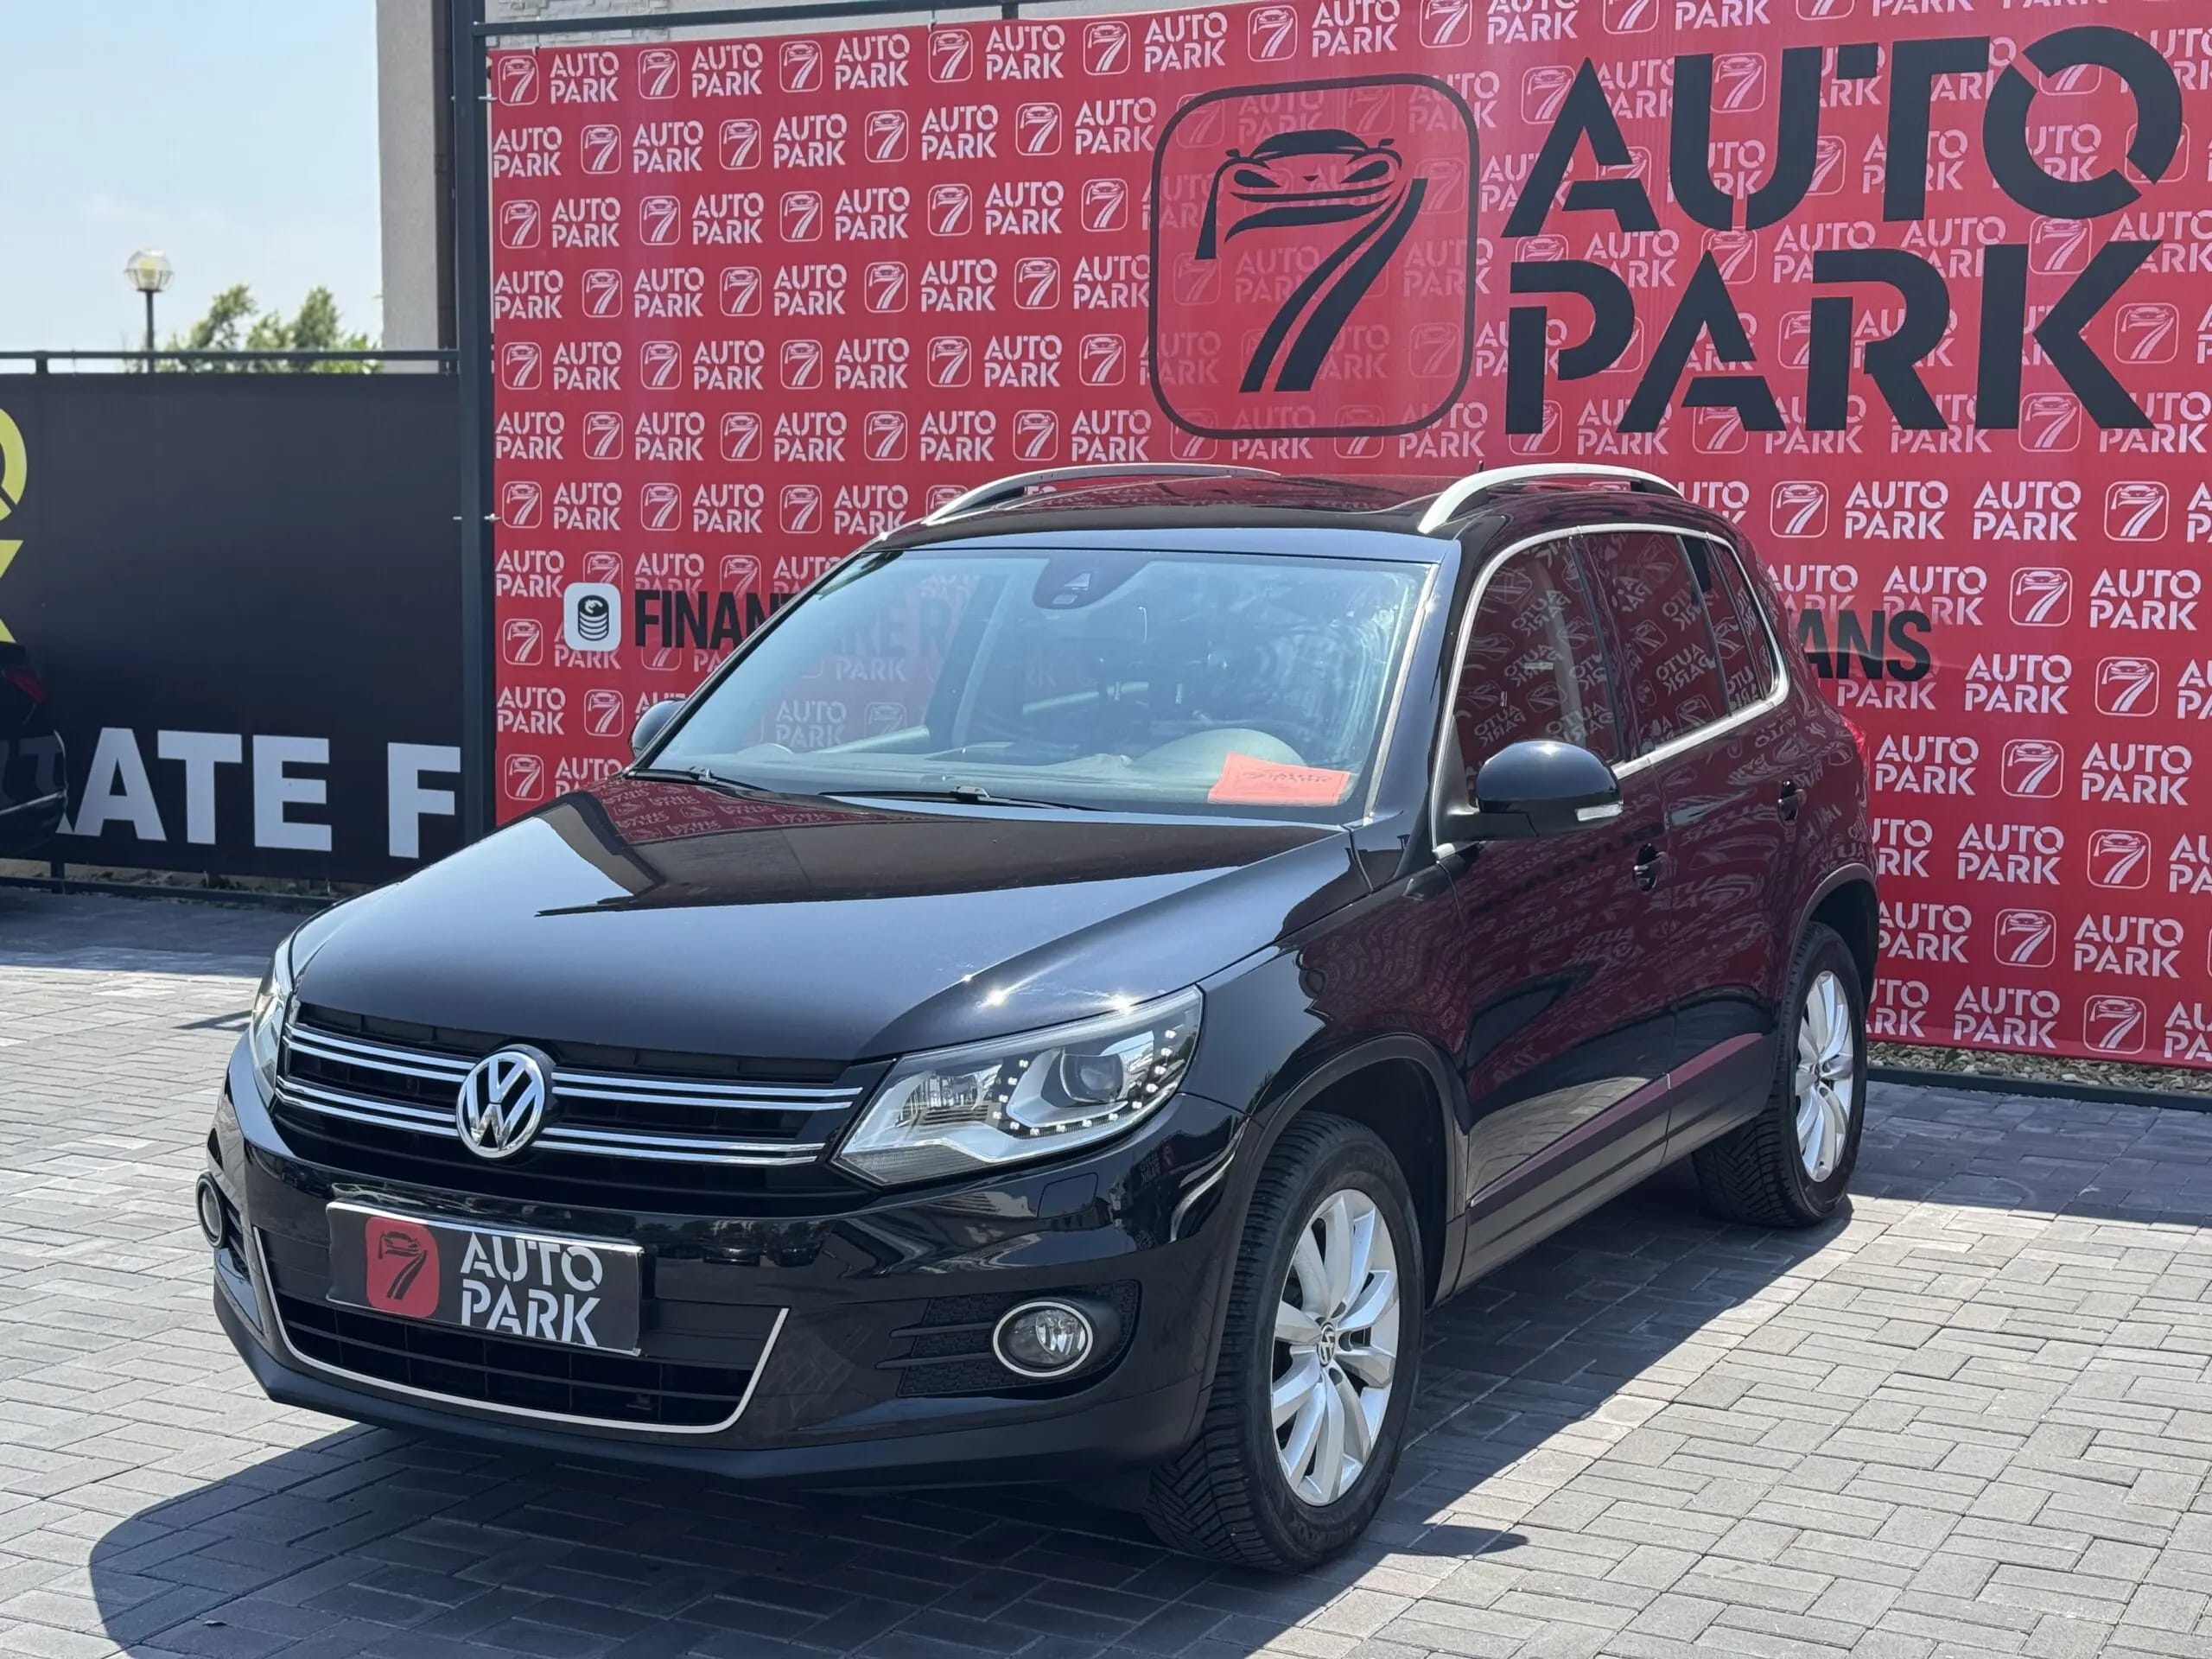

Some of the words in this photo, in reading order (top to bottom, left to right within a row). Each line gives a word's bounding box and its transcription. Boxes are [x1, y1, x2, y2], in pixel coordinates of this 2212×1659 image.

[1145, 12, 1227, 43] AUTO
[1313, 0, 1400, 28] AUTO
[1487, 10, 1578, 44] PARK
[1675, 0, 1771, 30] PARK
[835, 34, 910, 62] AUTO
[986, 25, 1065, 52] AUTO
[1313, 25, 1397, 57] PARK
[550, 52, 619, 78] AUTO
[691, 44, 763, 71] AUTO
[987, 53, 1063, 80] PARK
[1145, 39, 1225, 73] PARK
[692, 70, 761, 98] PARK
[836, 60, 908, 90] PARK
[551, 77, 618, 104] PARK
[921, 105, 998, 133] AUTO
[1075, 98, 1156, 126] AUTO
[493, 126, 562, 153] AUTO
[632, 121, 703, 147] AUTO
[773, 114, 847, 142] AUTO
[1076, 125, 1154, 155] PARK
[1501, 25, 2182, 237] AUTO
[2026, 124, 2102, 156] UTO
[774, 141, 845, 168] PARK
[922, 132, 996, 160] PARK
[493, 152, 561, 178] PARK
[633, 147, 702, 173] PARK
[692, 193, 764, 219] AUTO
[835, 187, 910, 213] AUTO
[985, 181, 1064, 207] AUTO
[552, 198, 620, 222] AUTO
[986, 208, 1061, 235] PARK
[552, 223, 619, 247] PARK
[693, 219, 762, 245] PARK
[836, 213, 908, 240] PARK
[1774, 217, 1876, 252] AUTO
[1901, 216, 2006, 248] AUTO
[2109, 210, 2212, 241] AUTO
[1584, 229, 1680, 259] AUTO
[634, 268, 704, 292] AUTO
[774, 264, 847, 289] AUTO
[921, 259, 997, 285] AUTO
[1073, 255, 1149, 282] AUTO
[494, 270, 563, 295] AUTO
[1074, 282, 1149, 308] PARK
[494, 295, 562, 319] PARK
[635, 293, 702, 318] PARK
[774, 290, 845, 315] PARK
[922, 286, 995, 312] PARK
[984, 335, 1062, 359] AUTO
[1505, 239, 2163, 433] PARK
[553, 341, 621, 365] AUTO
[693, 340, 764, 364] AUTO
[836, 338, 909, 362] AUTO
[554, 366, 620, 390] PARK
[695, 365, 763, 390] PARK
[836, 364, 907, 389] PARK
[985, 362, 1059, 387] PARK
[495, 412, 564, 435] AUTO
[635, 412, 704, 435] AUTO
[774, 412, 847, 435] AUTO
[920, 410, 995, 435] AUTO
[1071, 410, 1151, 435] AUTO
[496, 436, 563, 459] PARK
[636, 437, 702, 461] PARK
[775, 438, 844, 461] PARK
[921, 437, 994, 461] PARK
[1072, 436, 1148, 462] PARK
[1232, 437, 1314, 461] PARK
[1399, 432, 1486, 458] PARK
[1577, 430, 1669, 455] PARK
[1765, 426, 1863, 454] PARK
[1891, 429, 1993, 454] PARK
[2099, 424, 2208, 454] PARK
[554, 482, 621, 505] AUTO
[693, 484, 764, 507] AUTO
[834, 485, 908, 509] AUTO
[1846, 481, 1948, 509] AUTO
[1974, 481, 2081, 509] AUTO
[554, 506, 620, 530] PARK
[694, 509, 762, 532] PARK
[835, 511, 905, 535] PARK
[1846, 512, 1945, 539] PARK
[1974, 512, 2077, 540] PARK
[495, 550, 564, 573] AUTO
[635, 553, 704, 576] AUTO
[496, 574, 562, 597] PARK
[1883, 566, 1986, 594] AUTO
[2090, 569, 2201, 599] AUTO
[634, 589, 793, 650] FINAN
[2090, 600, 2197, 630] PARK
[555, 646, 621, 670] PARK
[1966, 654, 2071, 683] AUTO
[497, 687, 565, 710] AUTO
[1837, 679, 1936, 710] PARK
[1965, 683, 2068, 714] PARK
[498, 709, 563, 734] PARK
[776, 701, 847, 723] AUTO
[1876, 734, 1979, 765] AUTO
[2082, 742, 2191, 774] AUTO
[56, 726, 333, 851] ATE
[1876, 764, 1975, 795] PARK
[2082, 772, 2188, 805] PARK
[1958, 823, 2063, 854] AUTO
[1958, 852, 2060, 885] PARK
[2074, 914, 2183, 947] AUTO
[2075, 944, 2180, 978] PARK
[1955, 986, 2060, 1018] AUTO
[1954, 1014, 2056, 1049] PARK
[461, 1232, 602, 1292] AUTO
[461, 1279, 601, 1346] PARK
